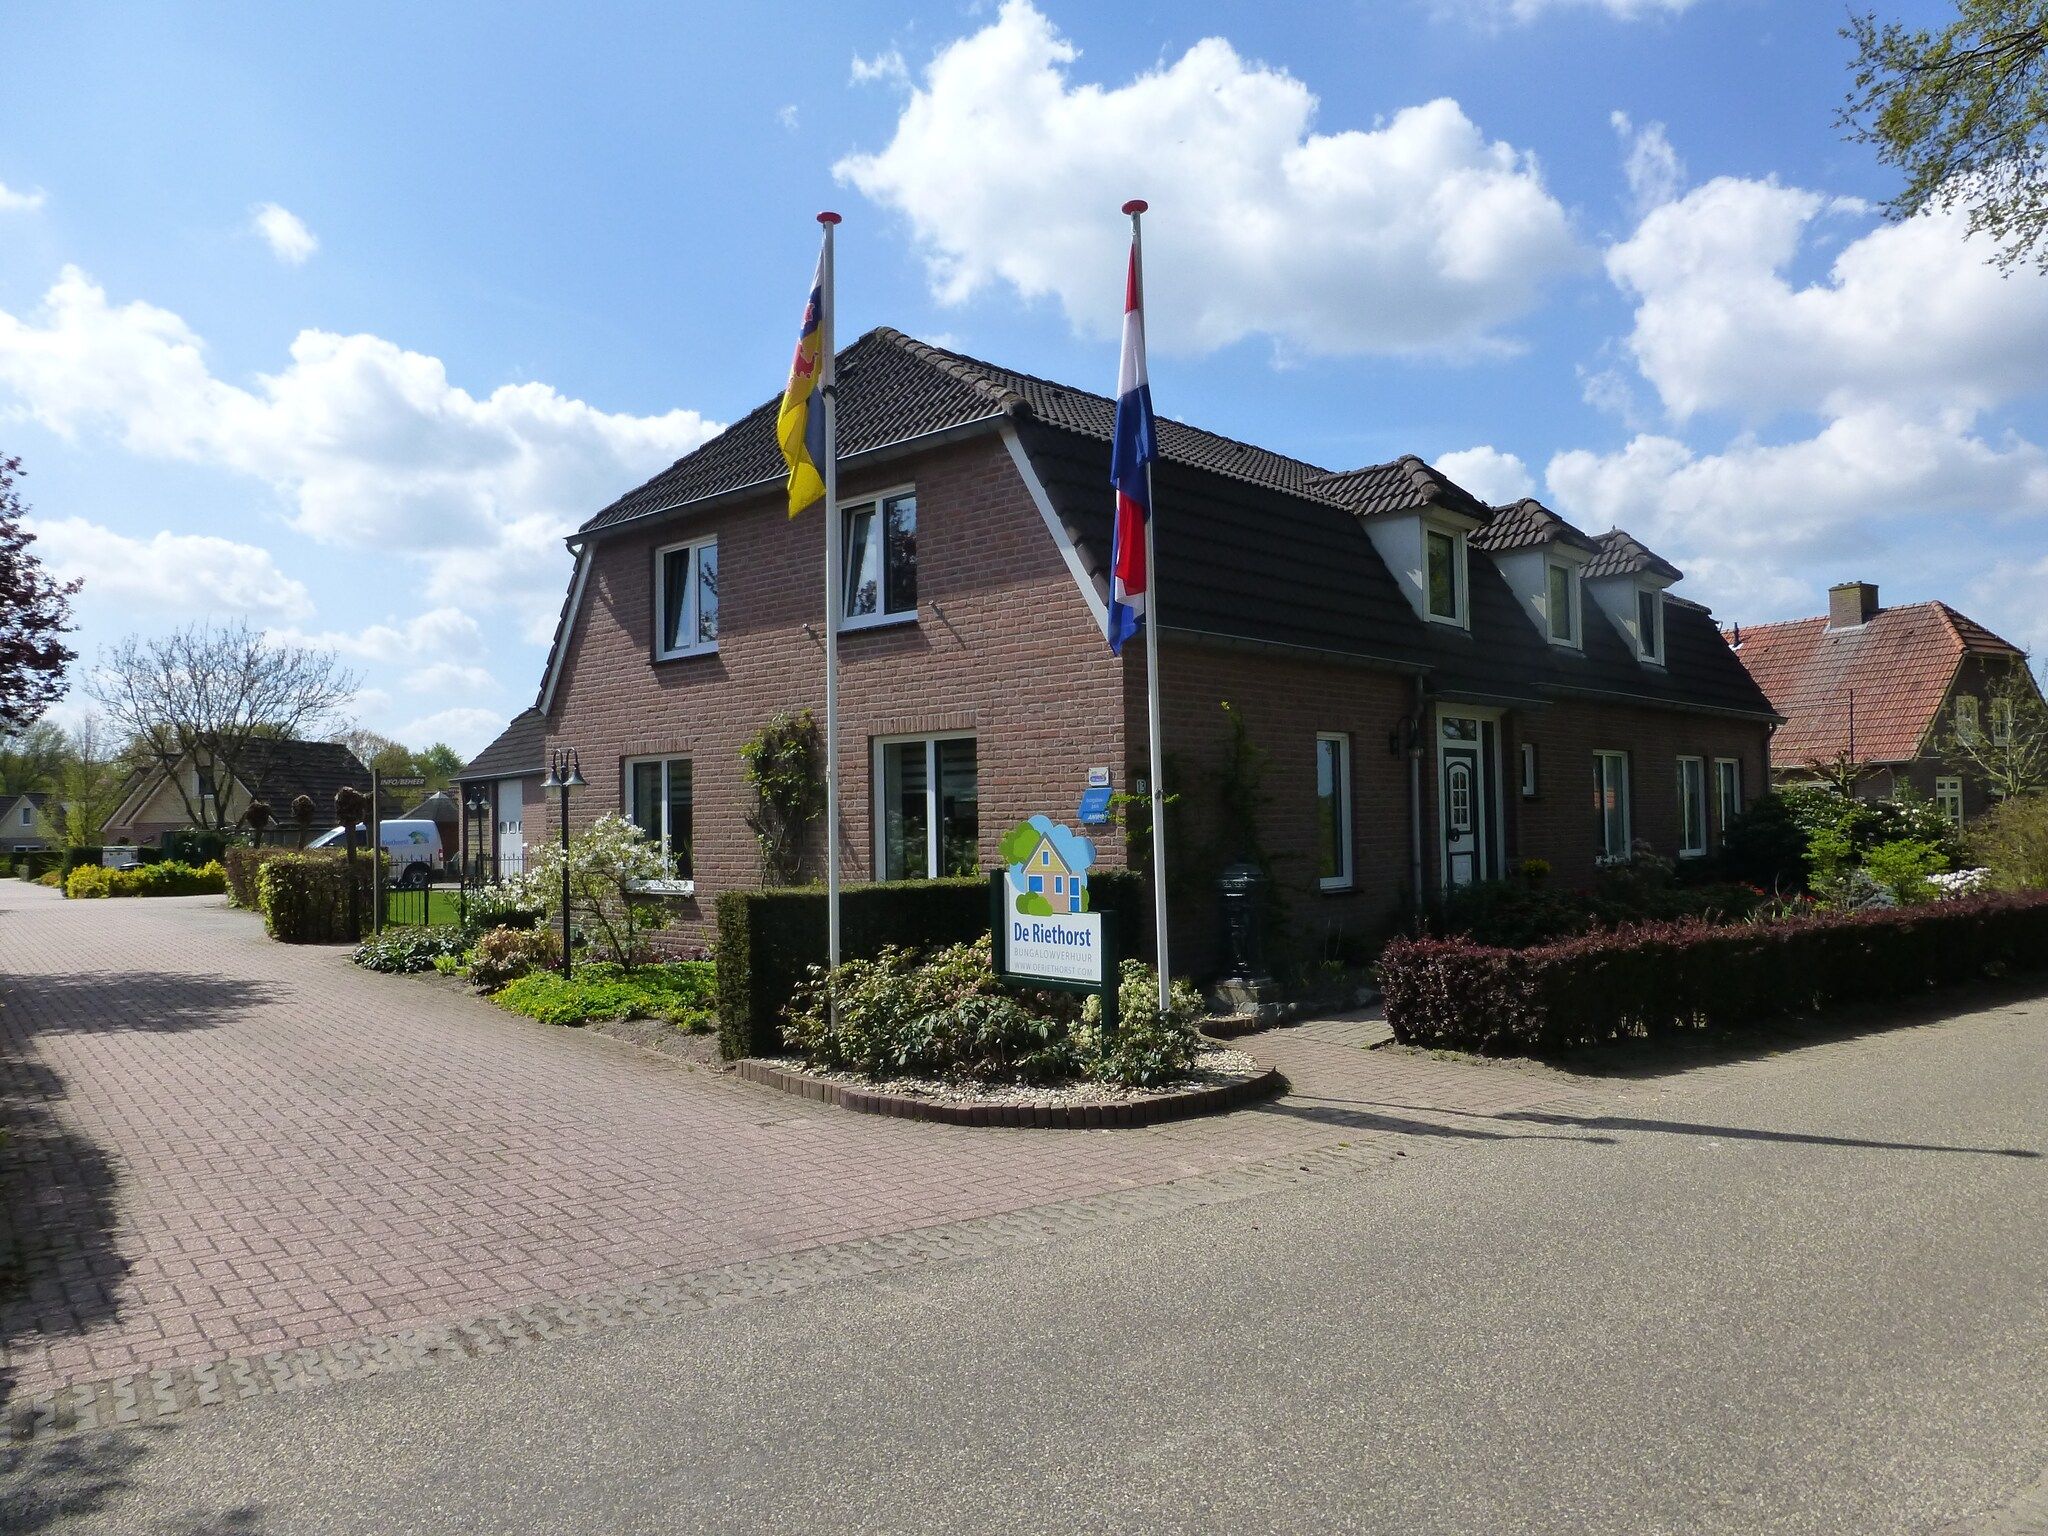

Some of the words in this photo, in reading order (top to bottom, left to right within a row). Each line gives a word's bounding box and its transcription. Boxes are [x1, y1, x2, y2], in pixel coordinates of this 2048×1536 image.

[380, 778, 425, 786] INFO/BEHEER
[1014, 922, 1029, 942] De
[1032, 923, 1091, 947] Riethorst
[1014, 947, 1092, 963] BUNGALOWVERHUUR
